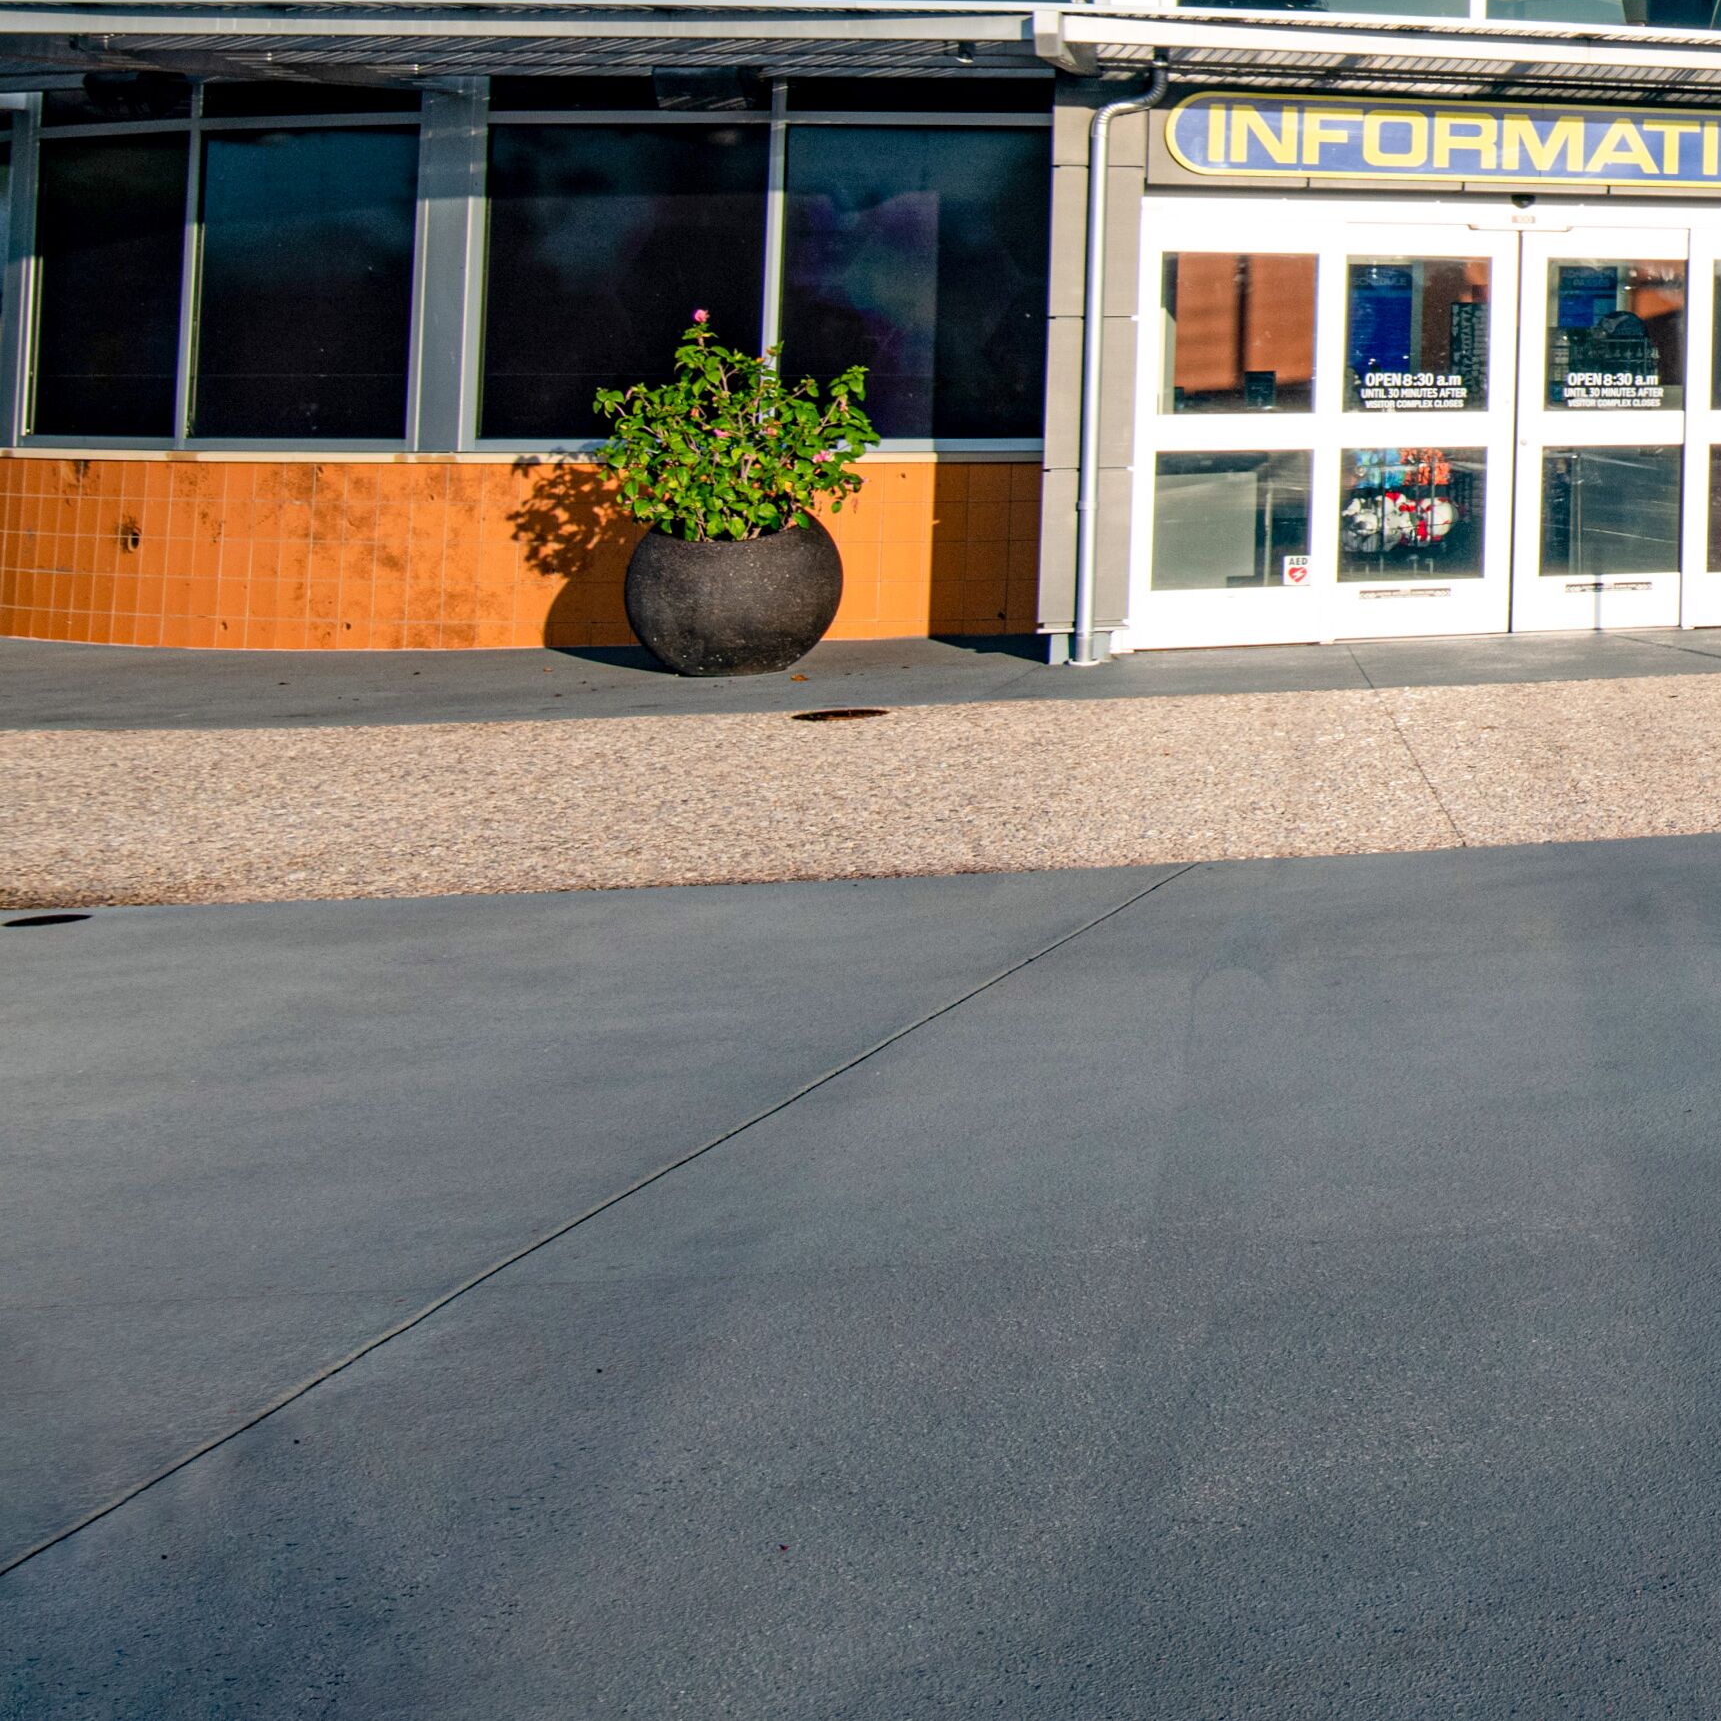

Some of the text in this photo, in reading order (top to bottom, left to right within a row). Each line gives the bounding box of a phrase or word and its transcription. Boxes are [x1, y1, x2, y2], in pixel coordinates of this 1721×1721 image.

[1365, 372, 1402, 386] OPEN
[1402, 372, 1434, 387] 8:30
[1567, 372, 1602, 386] OPEN
[1603, 372, 1633, 386] 8:30
[1361, 387, 1467, 398] UNTIL 30 MINUTES AFTER
[1564, 387, 1664, 398] UNTIL 30 MINUTES AFTER
[1289, 557, 1309, 565] AED
